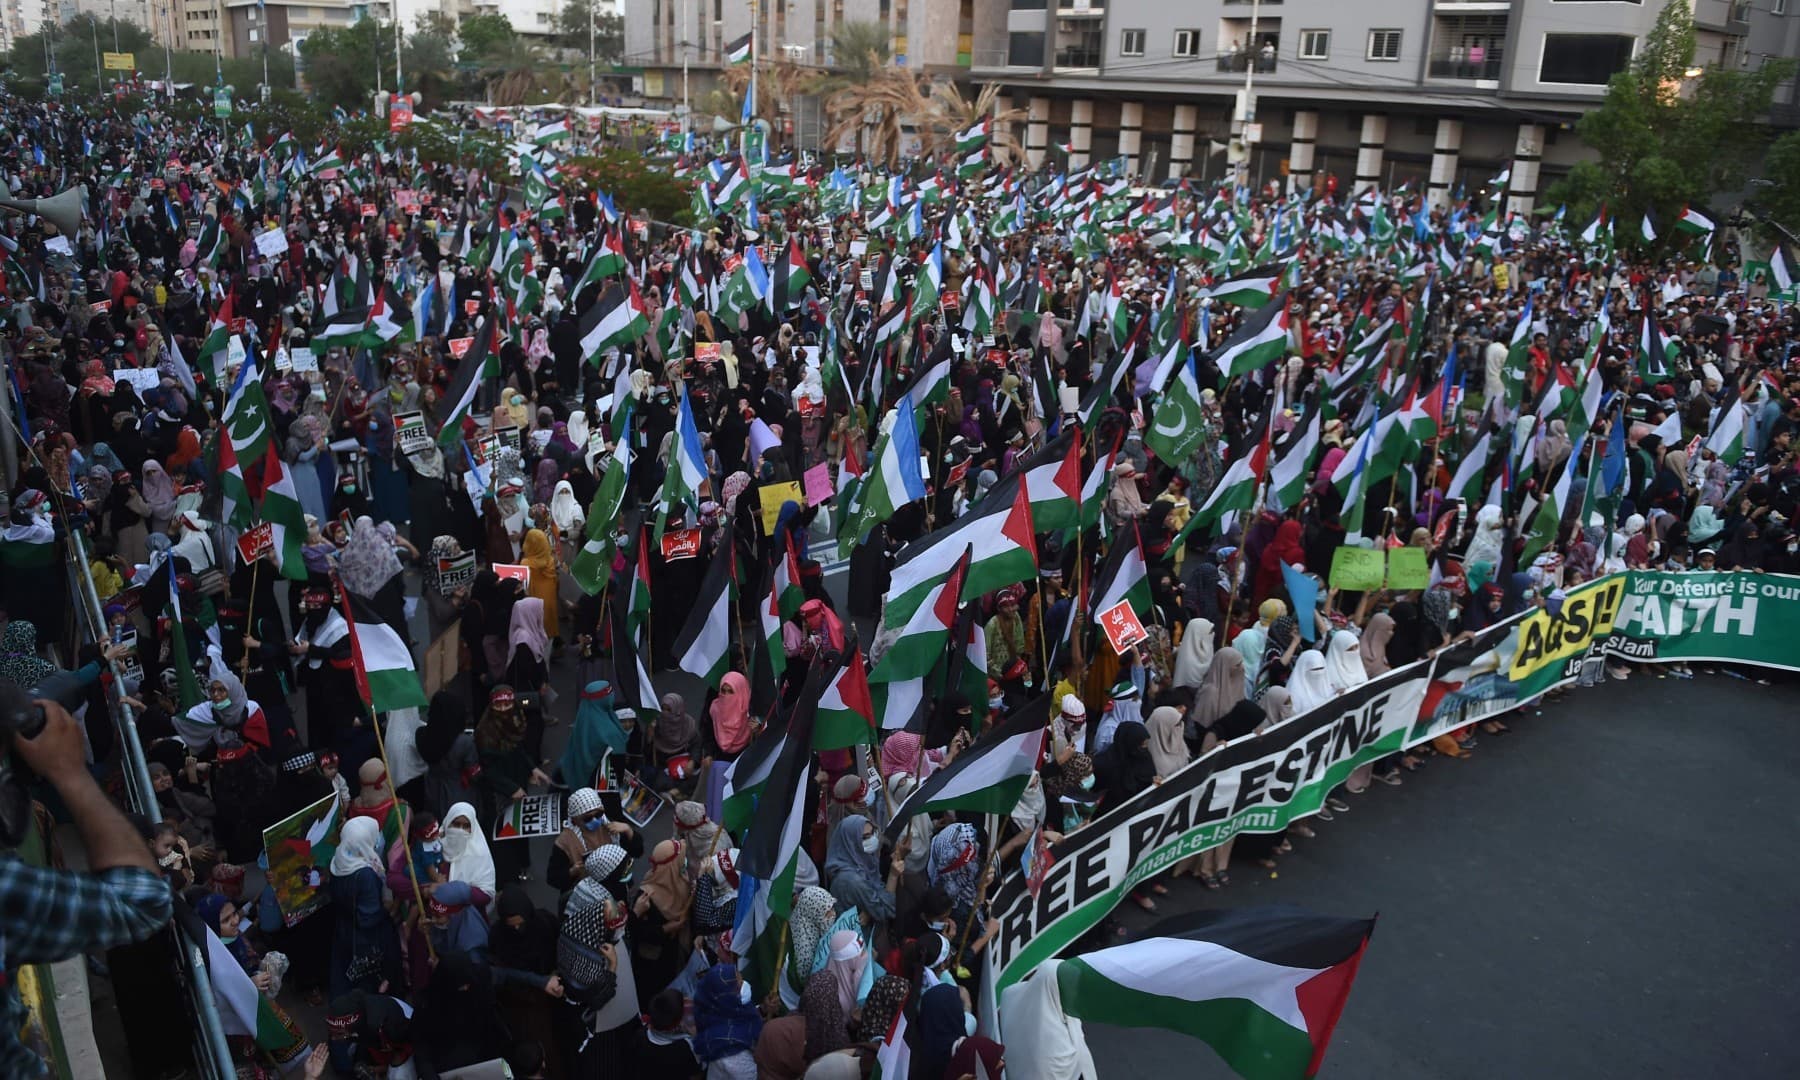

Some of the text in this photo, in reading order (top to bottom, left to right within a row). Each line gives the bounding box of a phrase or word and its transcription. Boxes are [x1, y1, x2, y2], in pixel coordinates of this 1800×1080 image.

[441, 565, 475, 583] FREE
[1634, 577, 1800, 601] Your Defence is our
[1613, 592, 1759, 636] FAITH
[1127, 693, 1391, 874] PALESTINE
[522, 797, 540, 836] FREE
